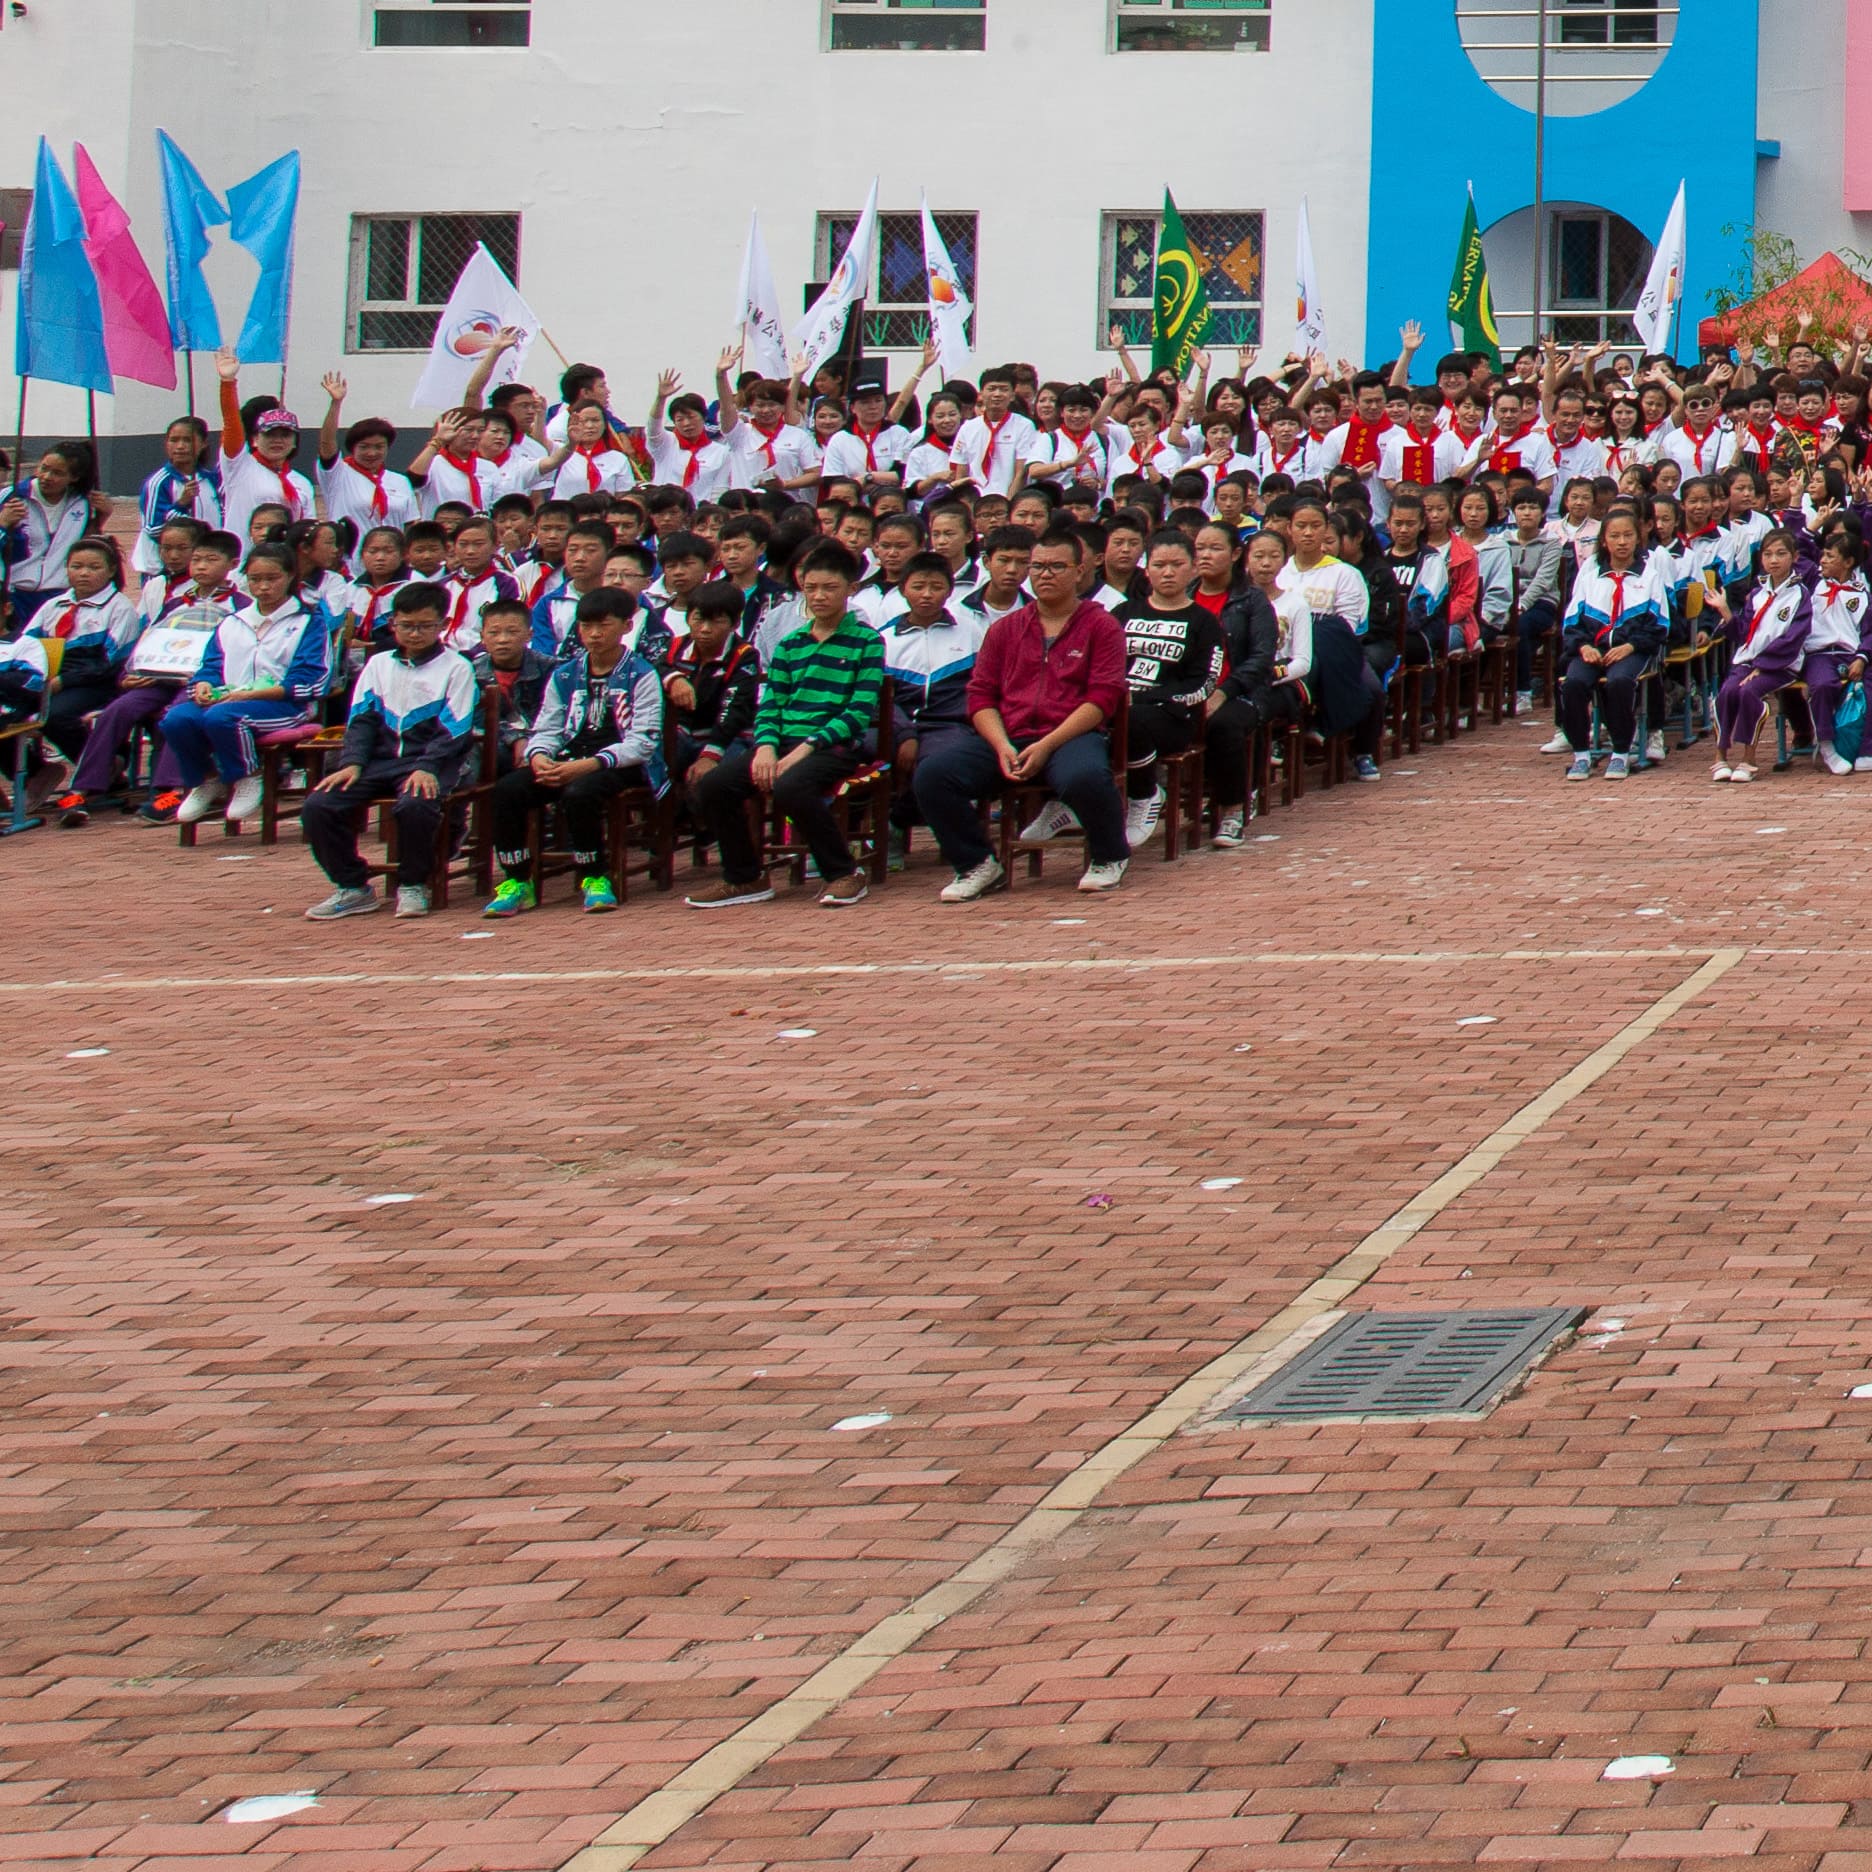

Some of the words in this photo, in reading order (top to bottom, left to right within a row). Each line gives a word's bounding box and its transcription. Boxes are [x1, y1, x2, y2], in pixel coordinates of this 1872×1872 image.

[1127, 621, 1164, 634] LOVE
[1169, 624, 1185, 636] TO
[1142, 641, 1184, 659] LOVED
